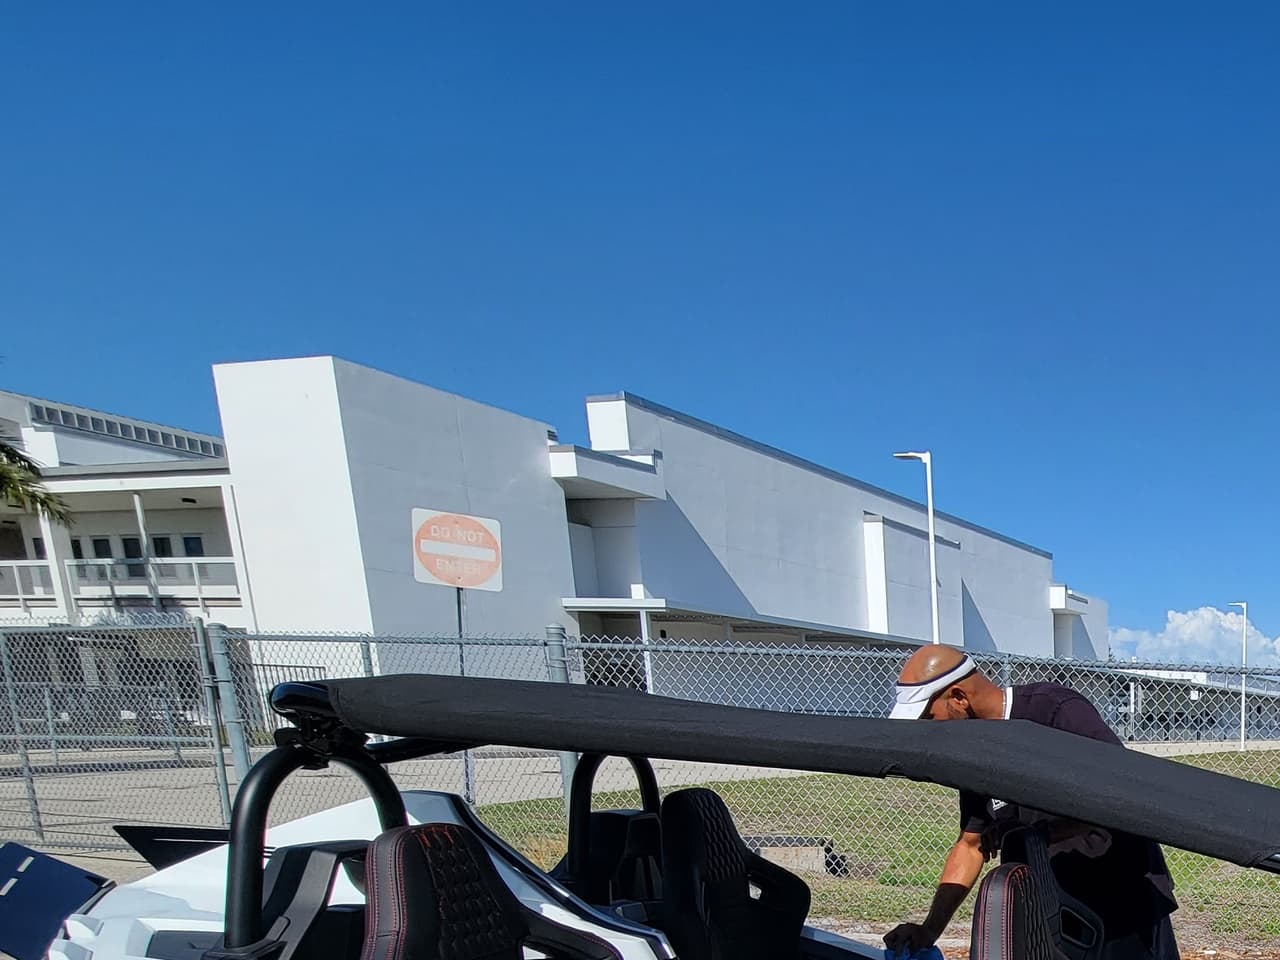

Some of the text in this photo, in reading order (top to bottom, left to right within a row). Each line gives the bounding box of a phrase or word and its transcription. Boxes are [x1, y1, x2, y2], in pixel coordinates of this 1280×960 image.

[430, 525, 484, 541] DO NOT
[436, 558, 482, 577] ENTER
